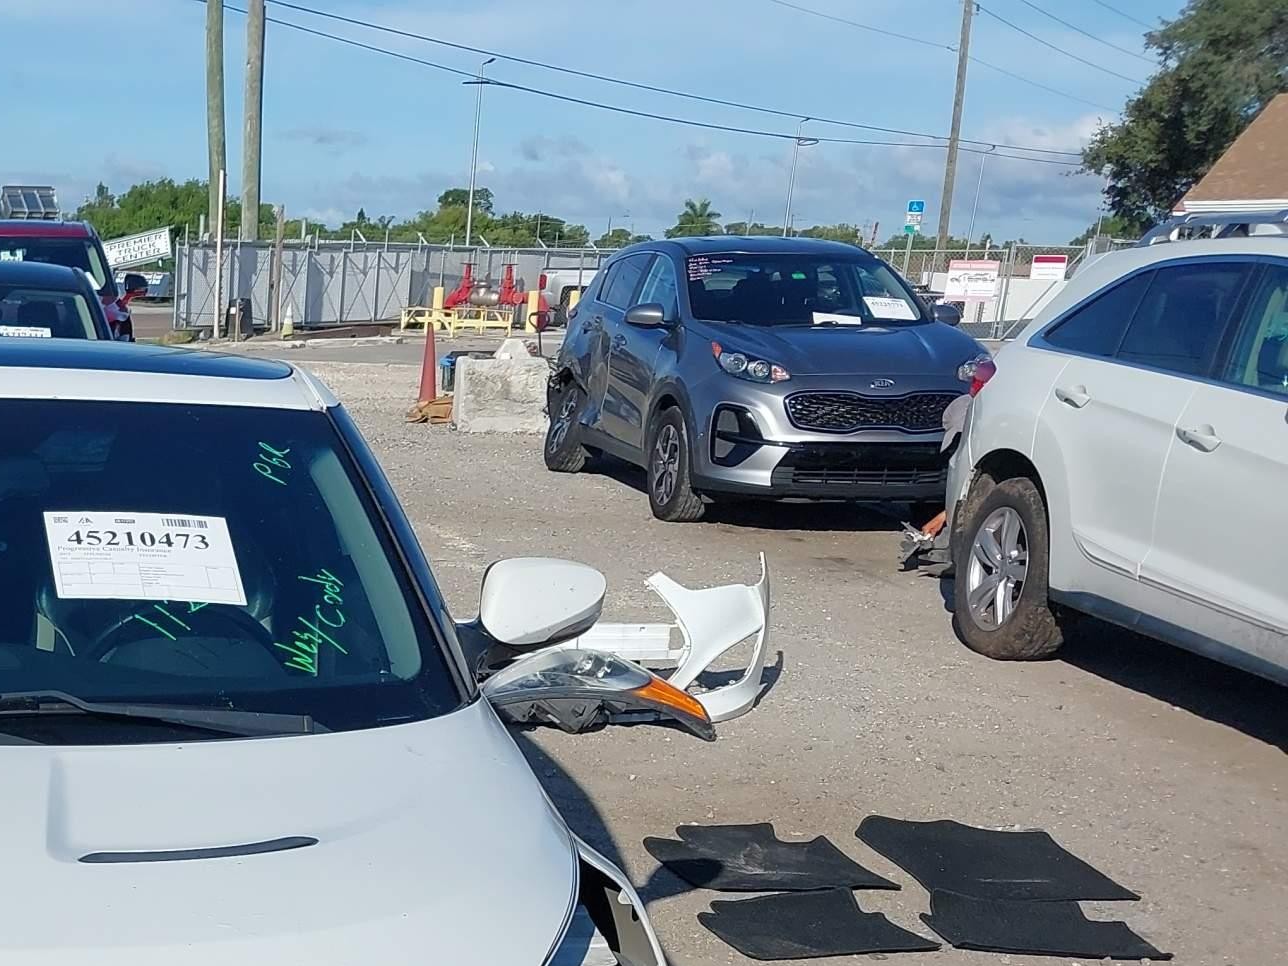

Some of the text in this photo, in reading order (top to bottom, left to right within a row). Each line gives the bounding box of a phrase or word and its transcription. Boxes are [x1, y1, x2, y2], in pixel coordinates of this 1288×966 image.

[109, 234, 162, 251] PREMIER
[118, 241, 157, 256] TRUCK
[114, 247, 161, 264] CENTER
[67, 529, 210, 550] 45210473
[57, 545, 101, 553] Progressive
